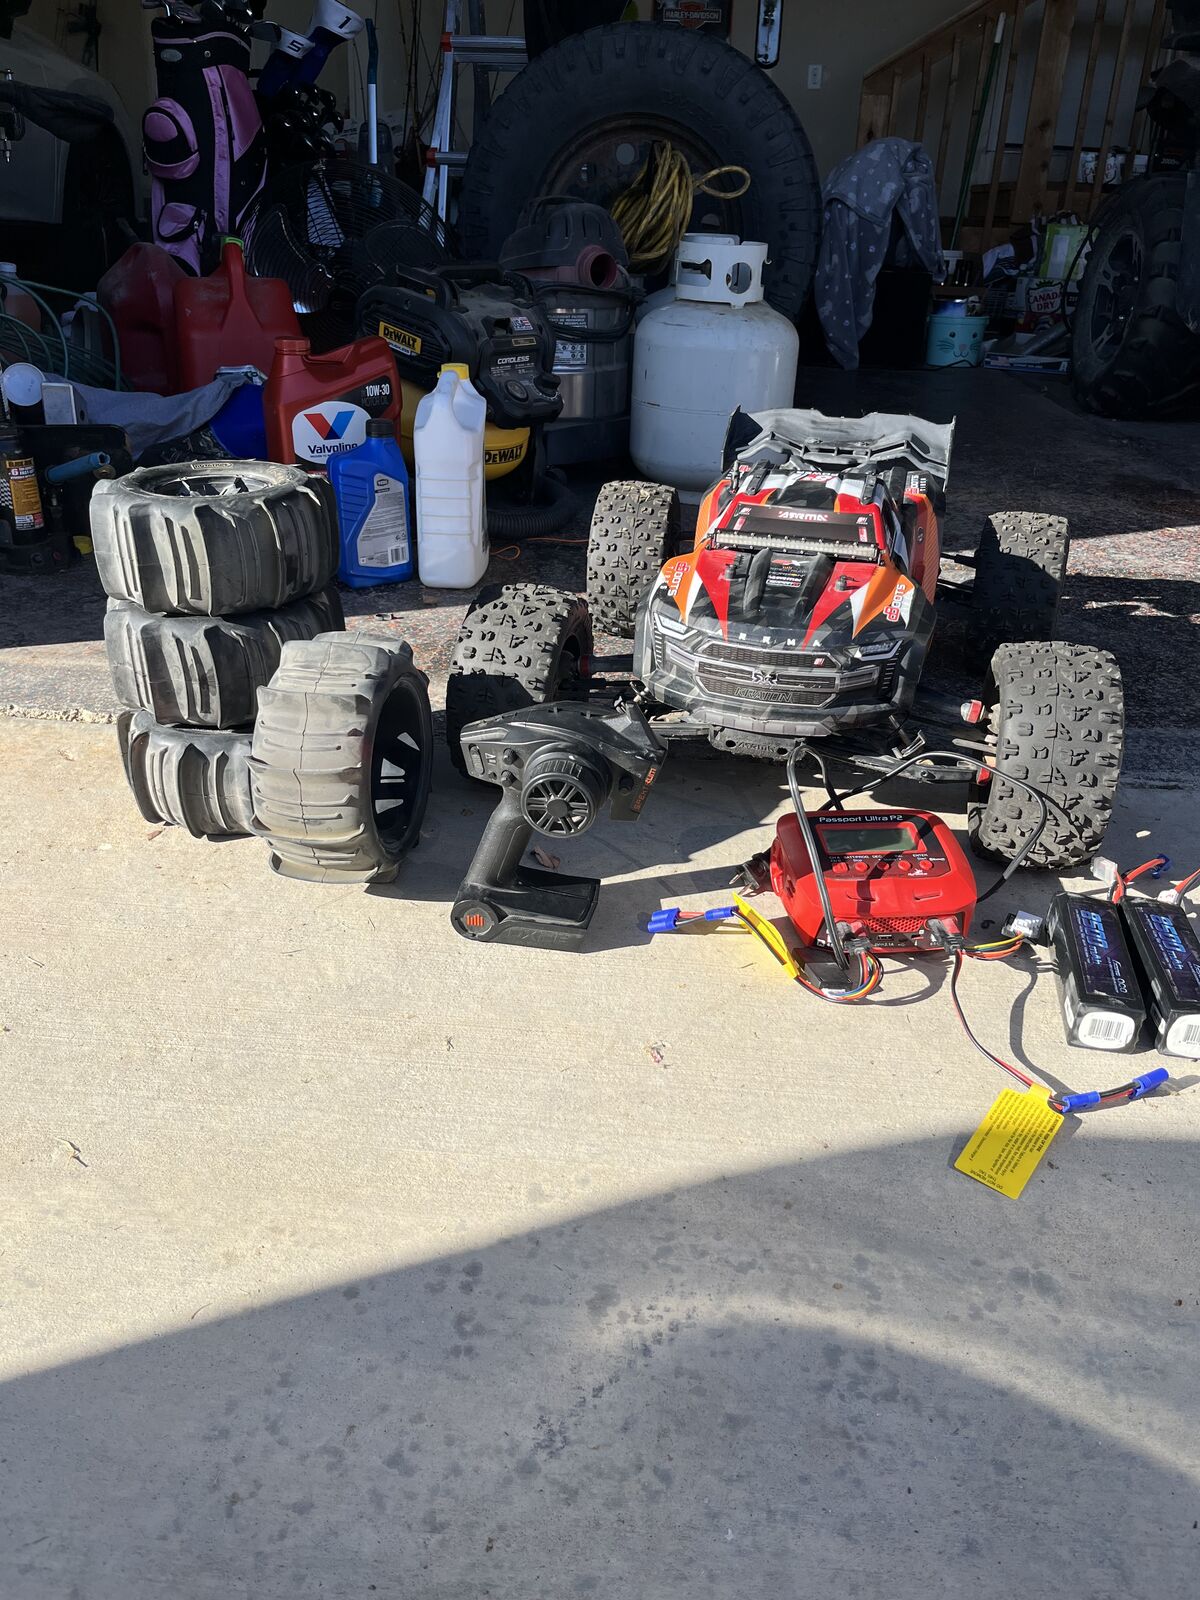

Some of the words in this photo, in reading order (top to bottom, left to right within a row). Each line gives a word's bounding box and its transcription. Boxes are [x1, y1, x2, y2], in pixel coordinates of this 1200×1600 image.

[665, 9, 720, 20] HARLEY-DAVIDSON
[338, 16, 352, 29] 1
[287, 40, 304, 53] 5
[1036, 300, 1056, 312] DRY
[383, 326, 418, 351] DEWALT
[497, 355, 530, 365] CORDLESS
[365, 383, 391, 397] 10W-30
[485, 444, 524, 465] DEWALT
[735, 686, 793, 703] KRATON
[819, 815, 862, 823] Passport
[865, 814, 889, 822] Ultra
[1080, 909, 1109, 951] 8500
[1150, 914, 1187, 953] 8500
